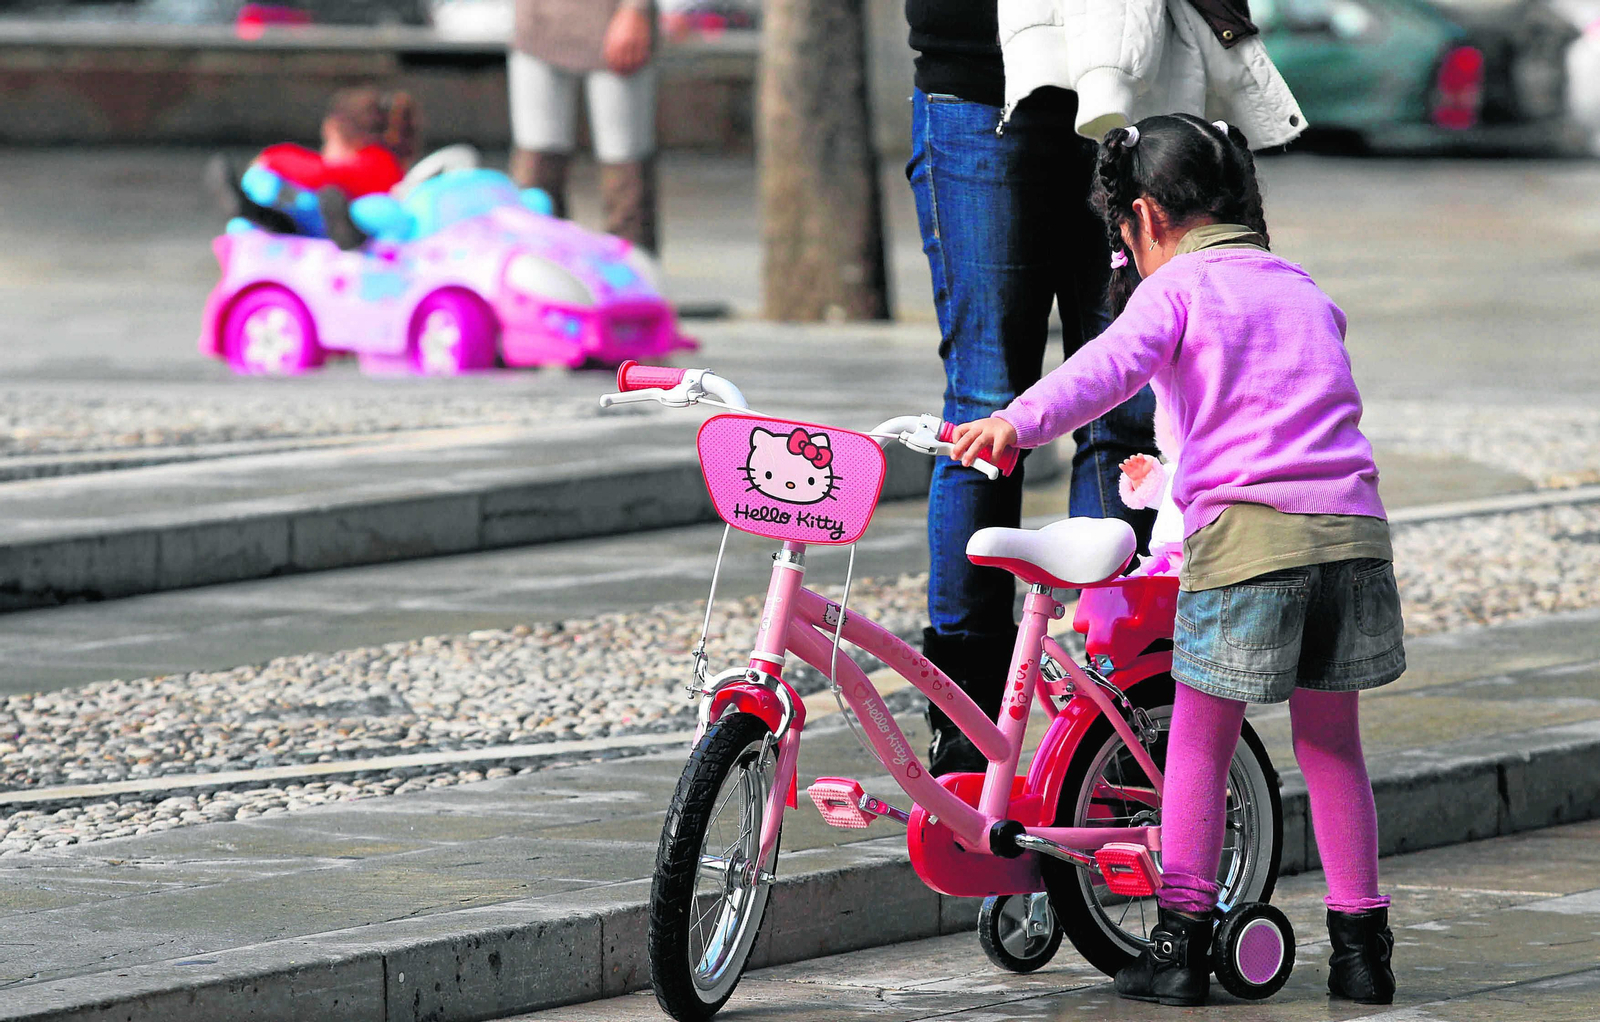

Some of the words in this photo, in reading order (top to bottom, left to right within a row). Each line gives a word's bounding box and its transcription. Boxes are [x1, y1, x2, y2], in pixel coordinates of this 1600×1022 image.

[733, 503, 791, 524] Hello
[796, 511, 846, 540] Kitty
[862, 698, 890, 733] Hello
[886, 732, 909, 765] Kitty
